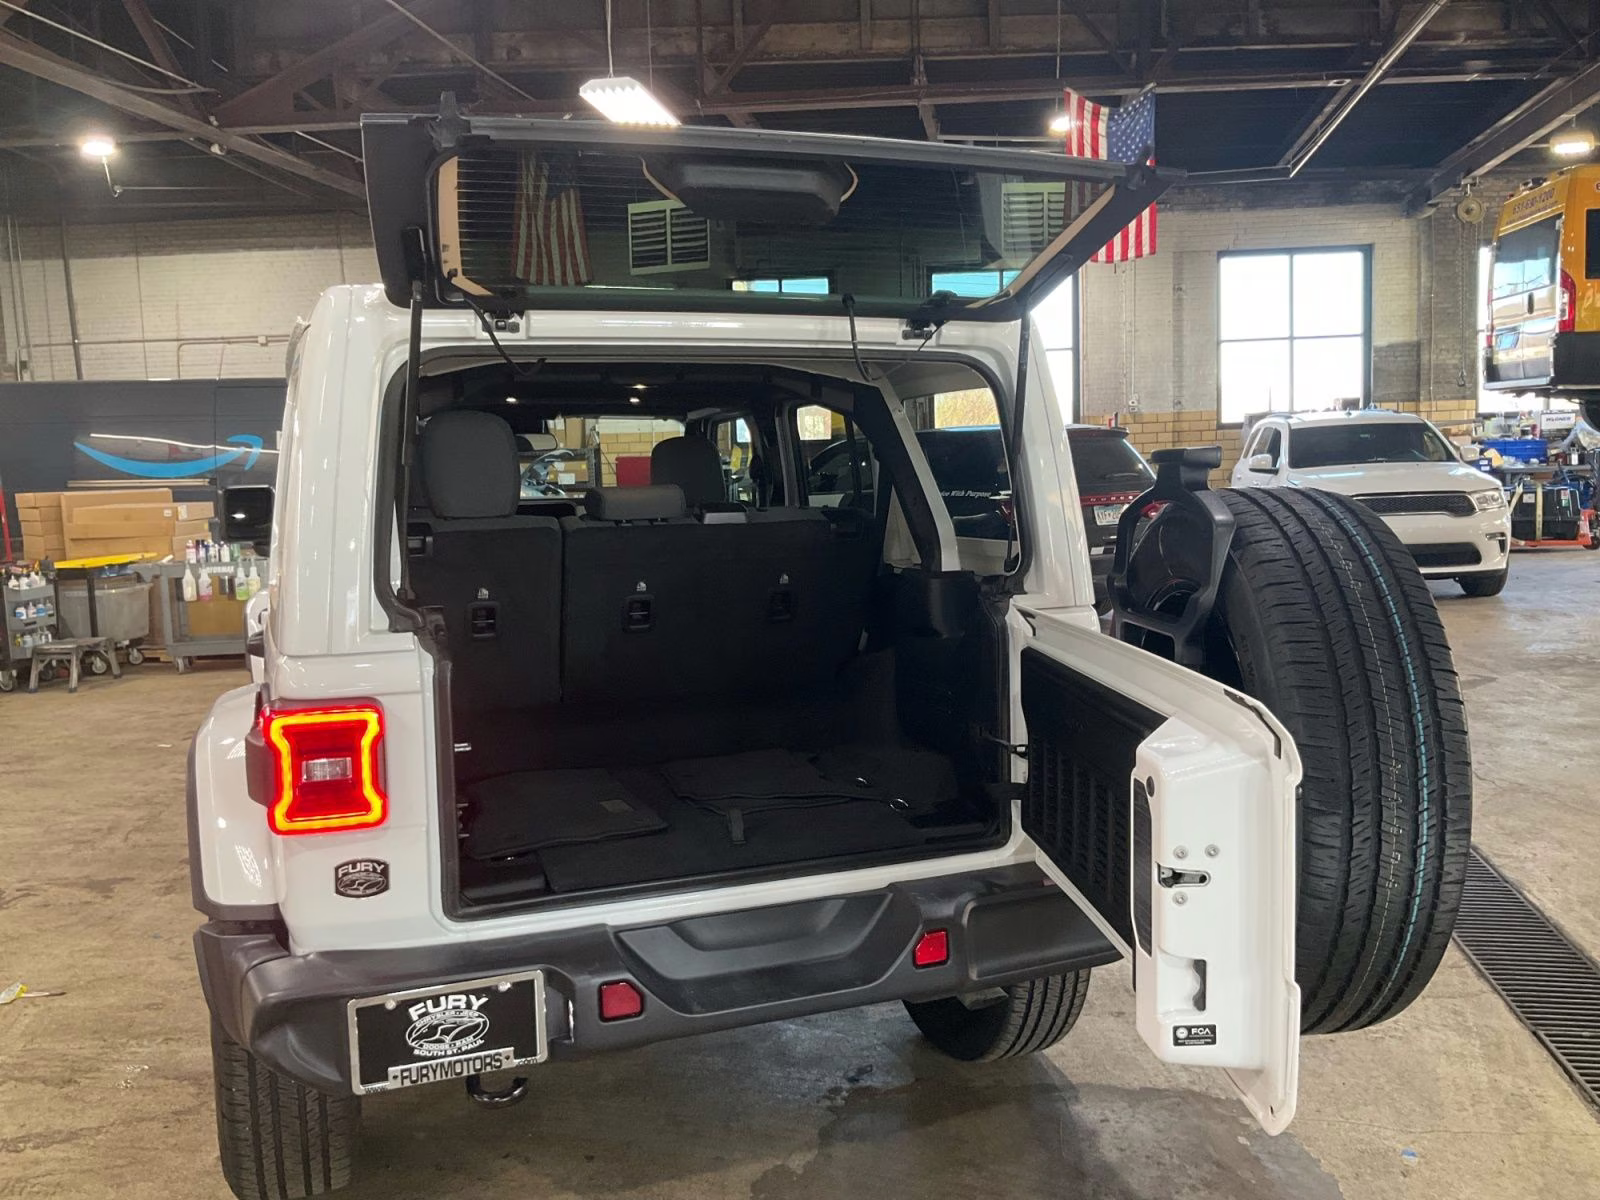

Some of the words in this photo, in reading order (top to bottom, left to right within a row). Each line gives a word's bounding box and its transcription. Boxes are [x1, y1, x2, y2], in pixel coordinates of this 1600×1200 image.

[965, 490, 992, 499] Purpose
[338, 862, 385, 878] FURY
[408, 994, 489, 1021] FURY
[1191, 1027, 1211, 1035] FCA
[414, 1047, 444, 1057] SOUTH
[447, 1047, 461, 1056] ST.
[462, 1039, 485, 1051] PAUL
[400, 1052, 503, 1086] FURYMOTORS
